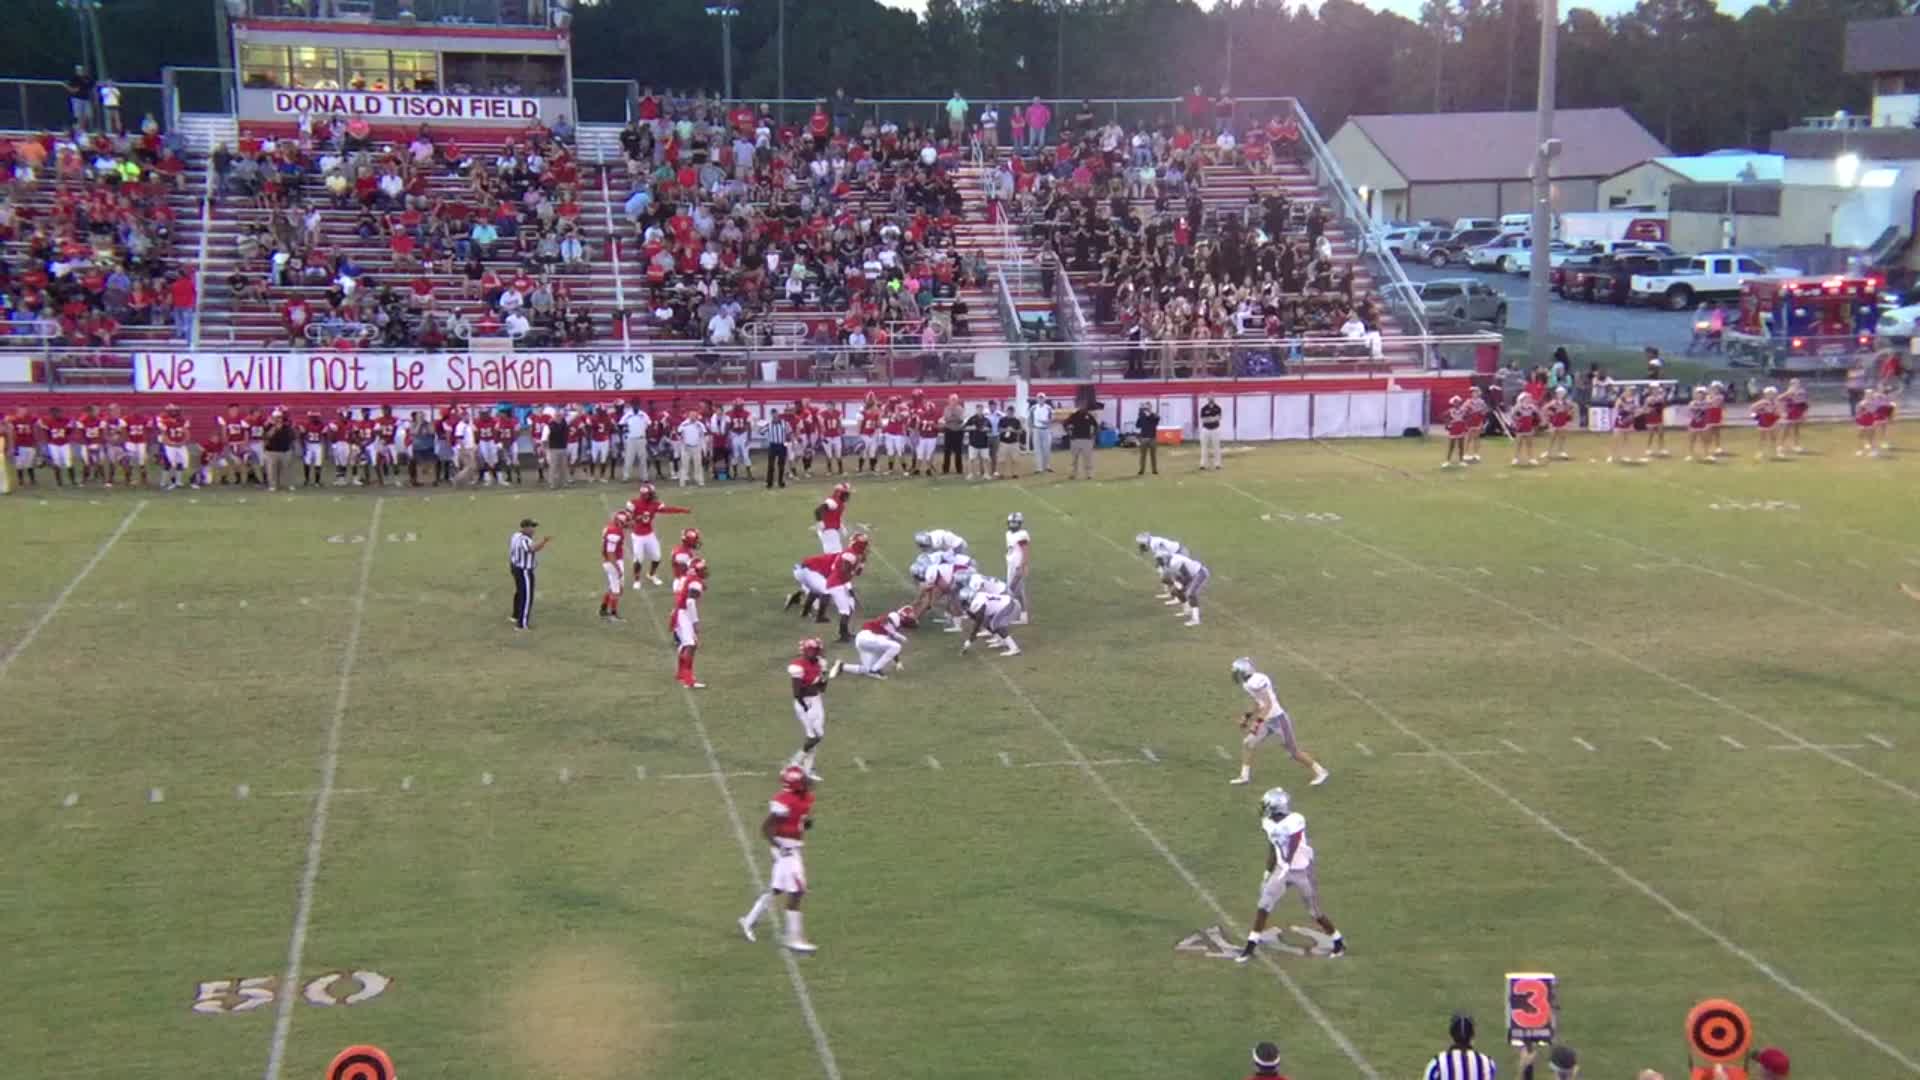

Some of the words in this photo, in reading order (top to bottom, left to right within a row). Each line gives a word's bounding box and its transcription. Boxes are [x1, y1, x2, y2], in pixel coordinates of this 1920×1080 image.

[276, 93, 381, 114] DONALD
[387, 97, 463, 117] TISON
[470, 99, 538, 118] FIELD
[146, 354, 196, 391] We
[308, 356, 369, 391] not
[392, 356, 424, 391] be
[576, 354, 645, 374] PSALMS
[191, 969, 395, 1014] 50
[1511, 979, 1552, 1028] 3
